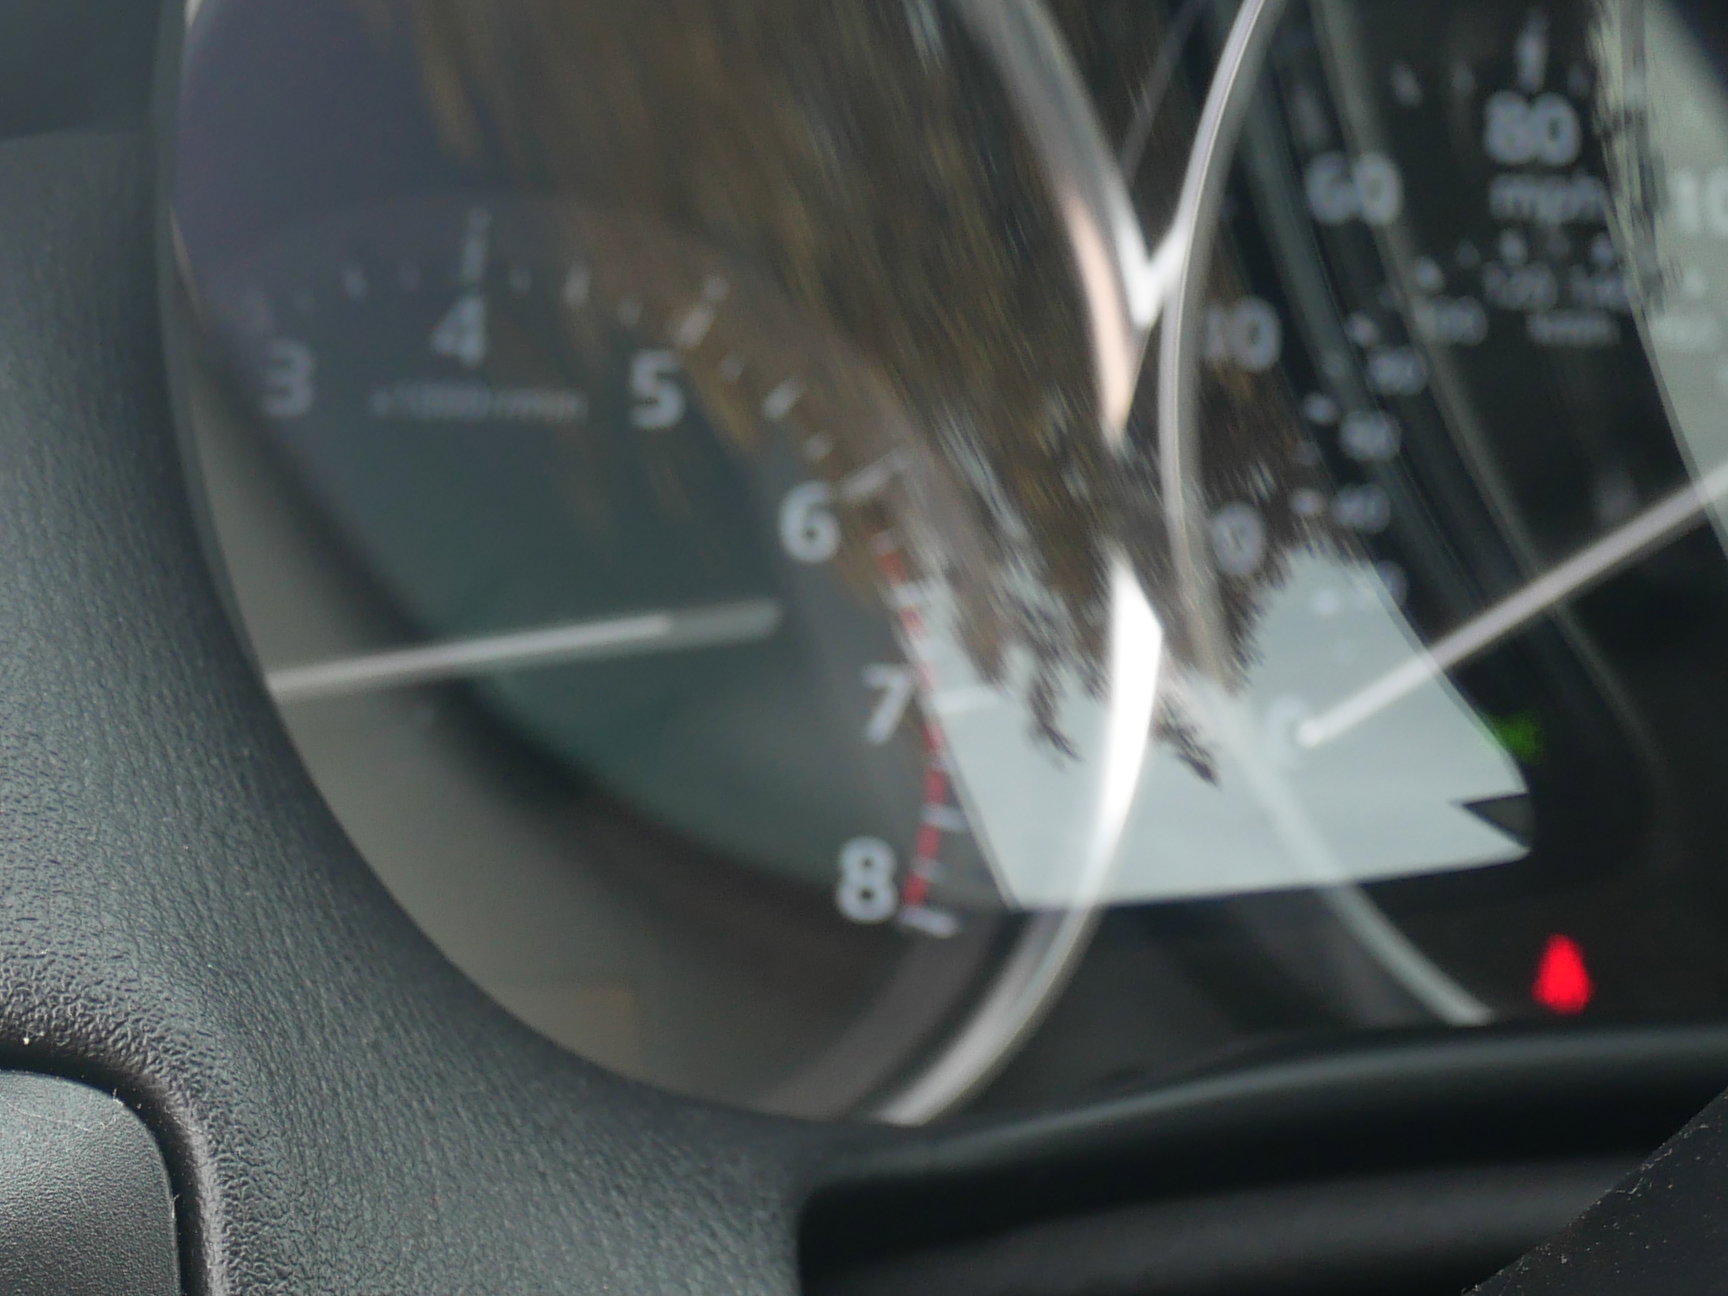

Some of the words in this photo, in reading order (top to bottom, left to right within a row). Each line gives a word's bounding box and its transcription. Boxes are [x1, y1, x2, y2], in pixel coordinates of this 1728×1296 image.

[430, 296, 486, 367] 4
[262, 338, 316, 419] 3
[630, 348, 685, 430] 5
[779, 480, 840, 563] 6
[863, 664, 911, 745] 7
[836, 838, 899, 925] 8
